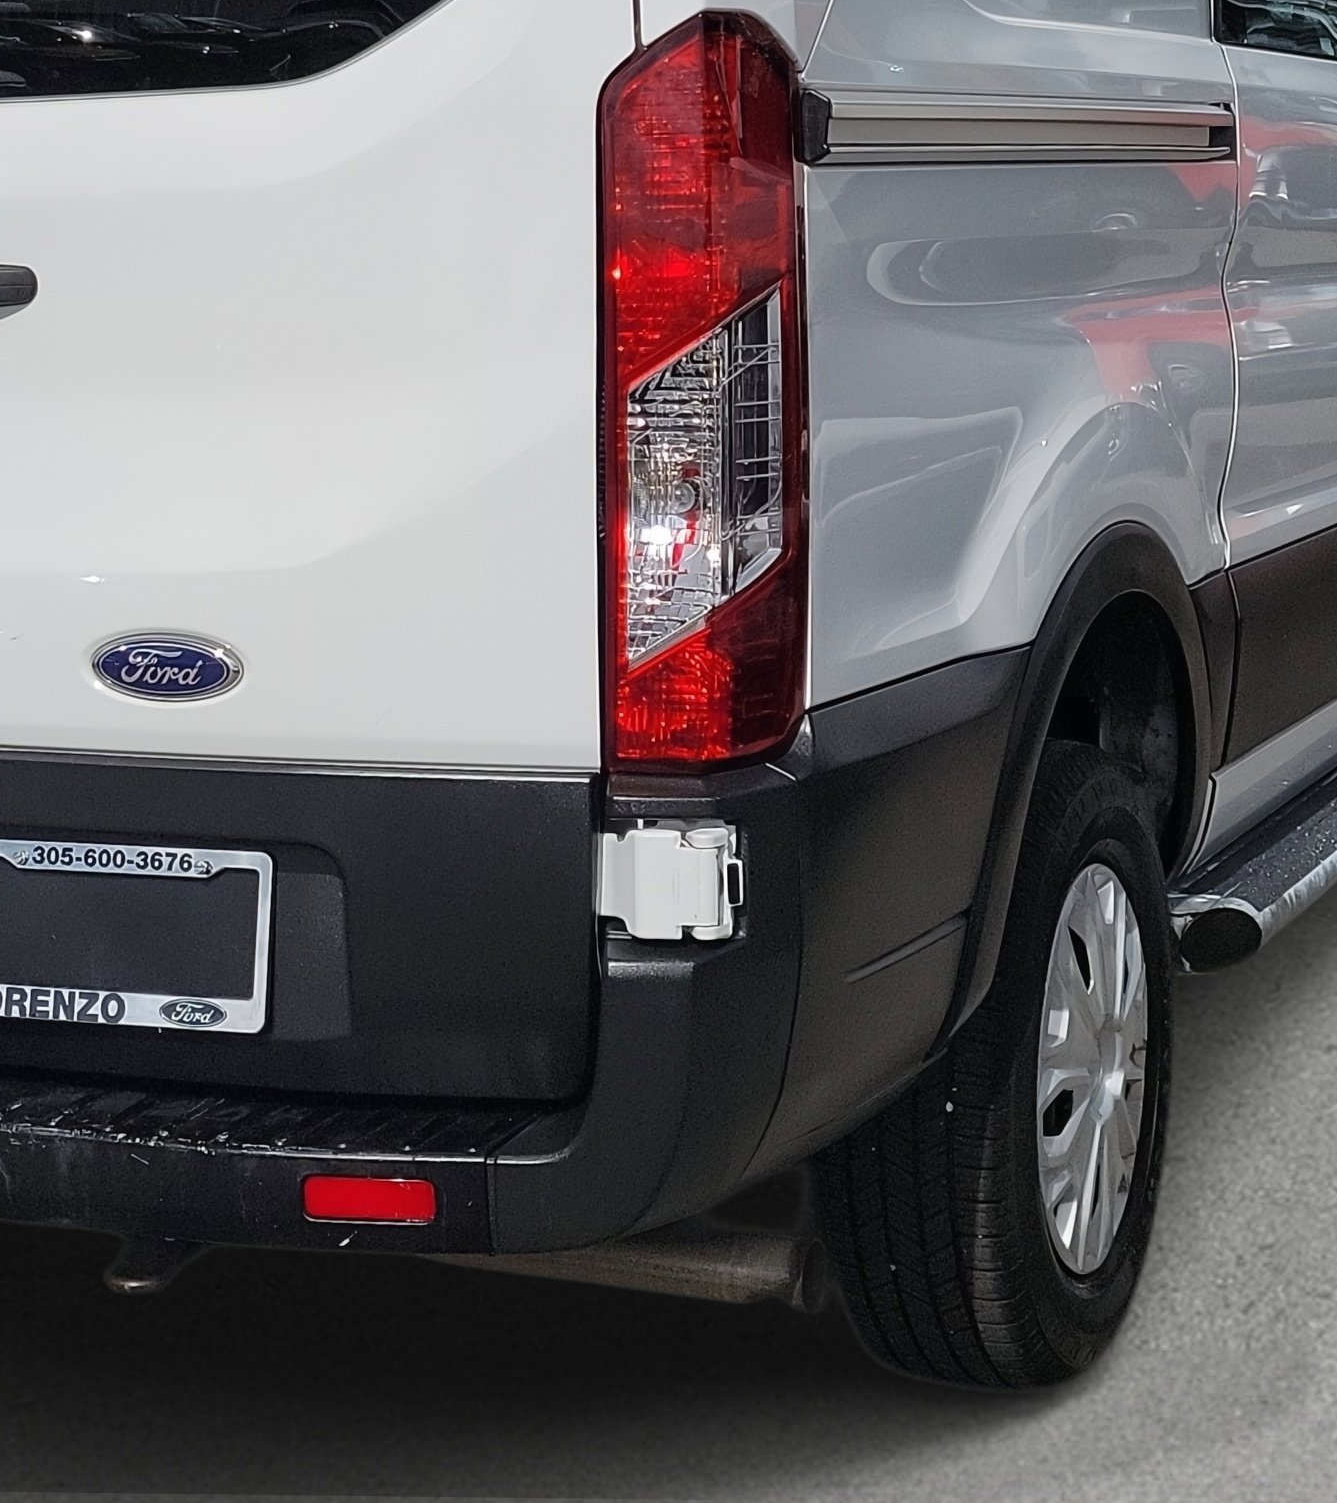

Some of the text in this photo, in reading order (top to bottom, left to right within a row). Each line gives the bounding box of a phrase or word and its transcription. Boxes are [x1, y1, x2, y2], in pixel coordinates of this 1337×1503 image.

[120, 648, 203, 685] Ford
[31, 845, 194, 873] 305-600-3676
[170, 1001, 214, 1025] Ford
